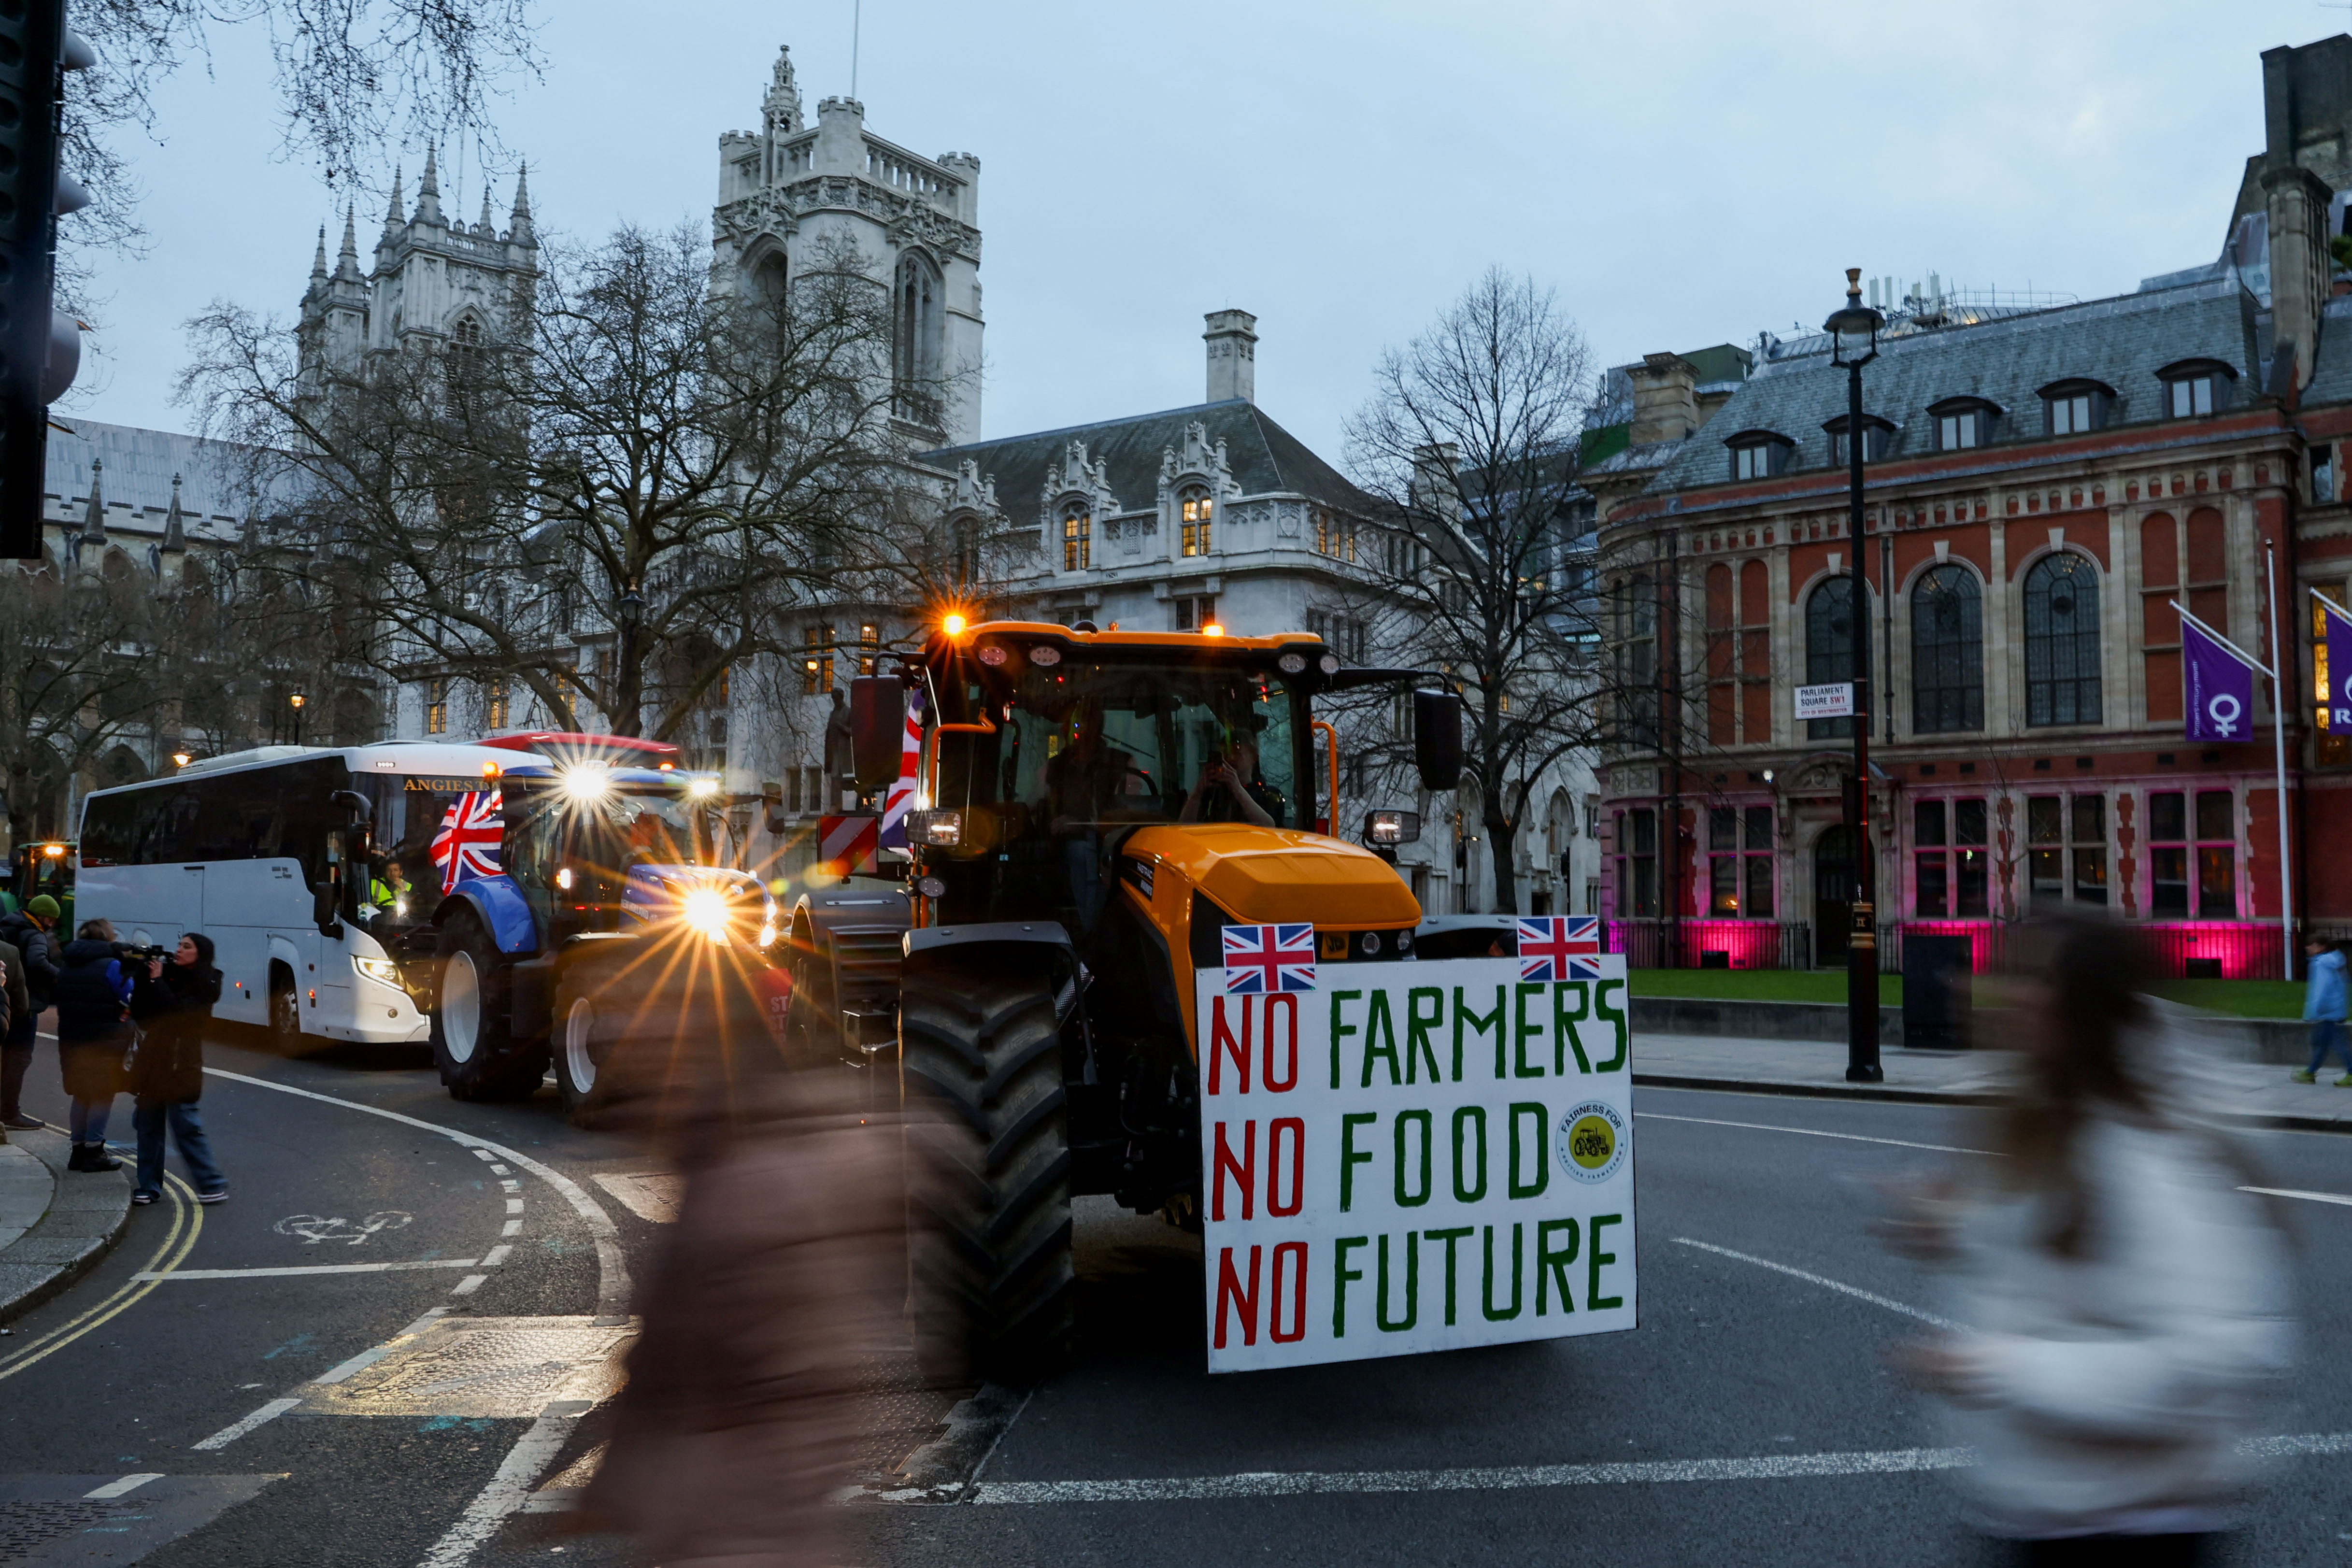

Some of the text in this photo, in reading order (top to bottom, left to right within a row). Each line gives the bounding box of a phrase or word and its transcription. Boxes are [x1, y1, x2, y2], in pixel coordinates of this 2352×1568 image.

[1800, 686, 1844, 697] PARLIAMENT
[1801, 696, 1844, 706] SQUARE SW1
[403, 779, 473, 791] ANGIES
[1208, 979, 1627, 1095] NO FARMERS
[1561, 1104, 1622, 1133] FAIRNESS FOR
[1212, 1102, 1549, 1221] NO FOOD
[1213, 1214, 1623, 1349] NO FUTURE
